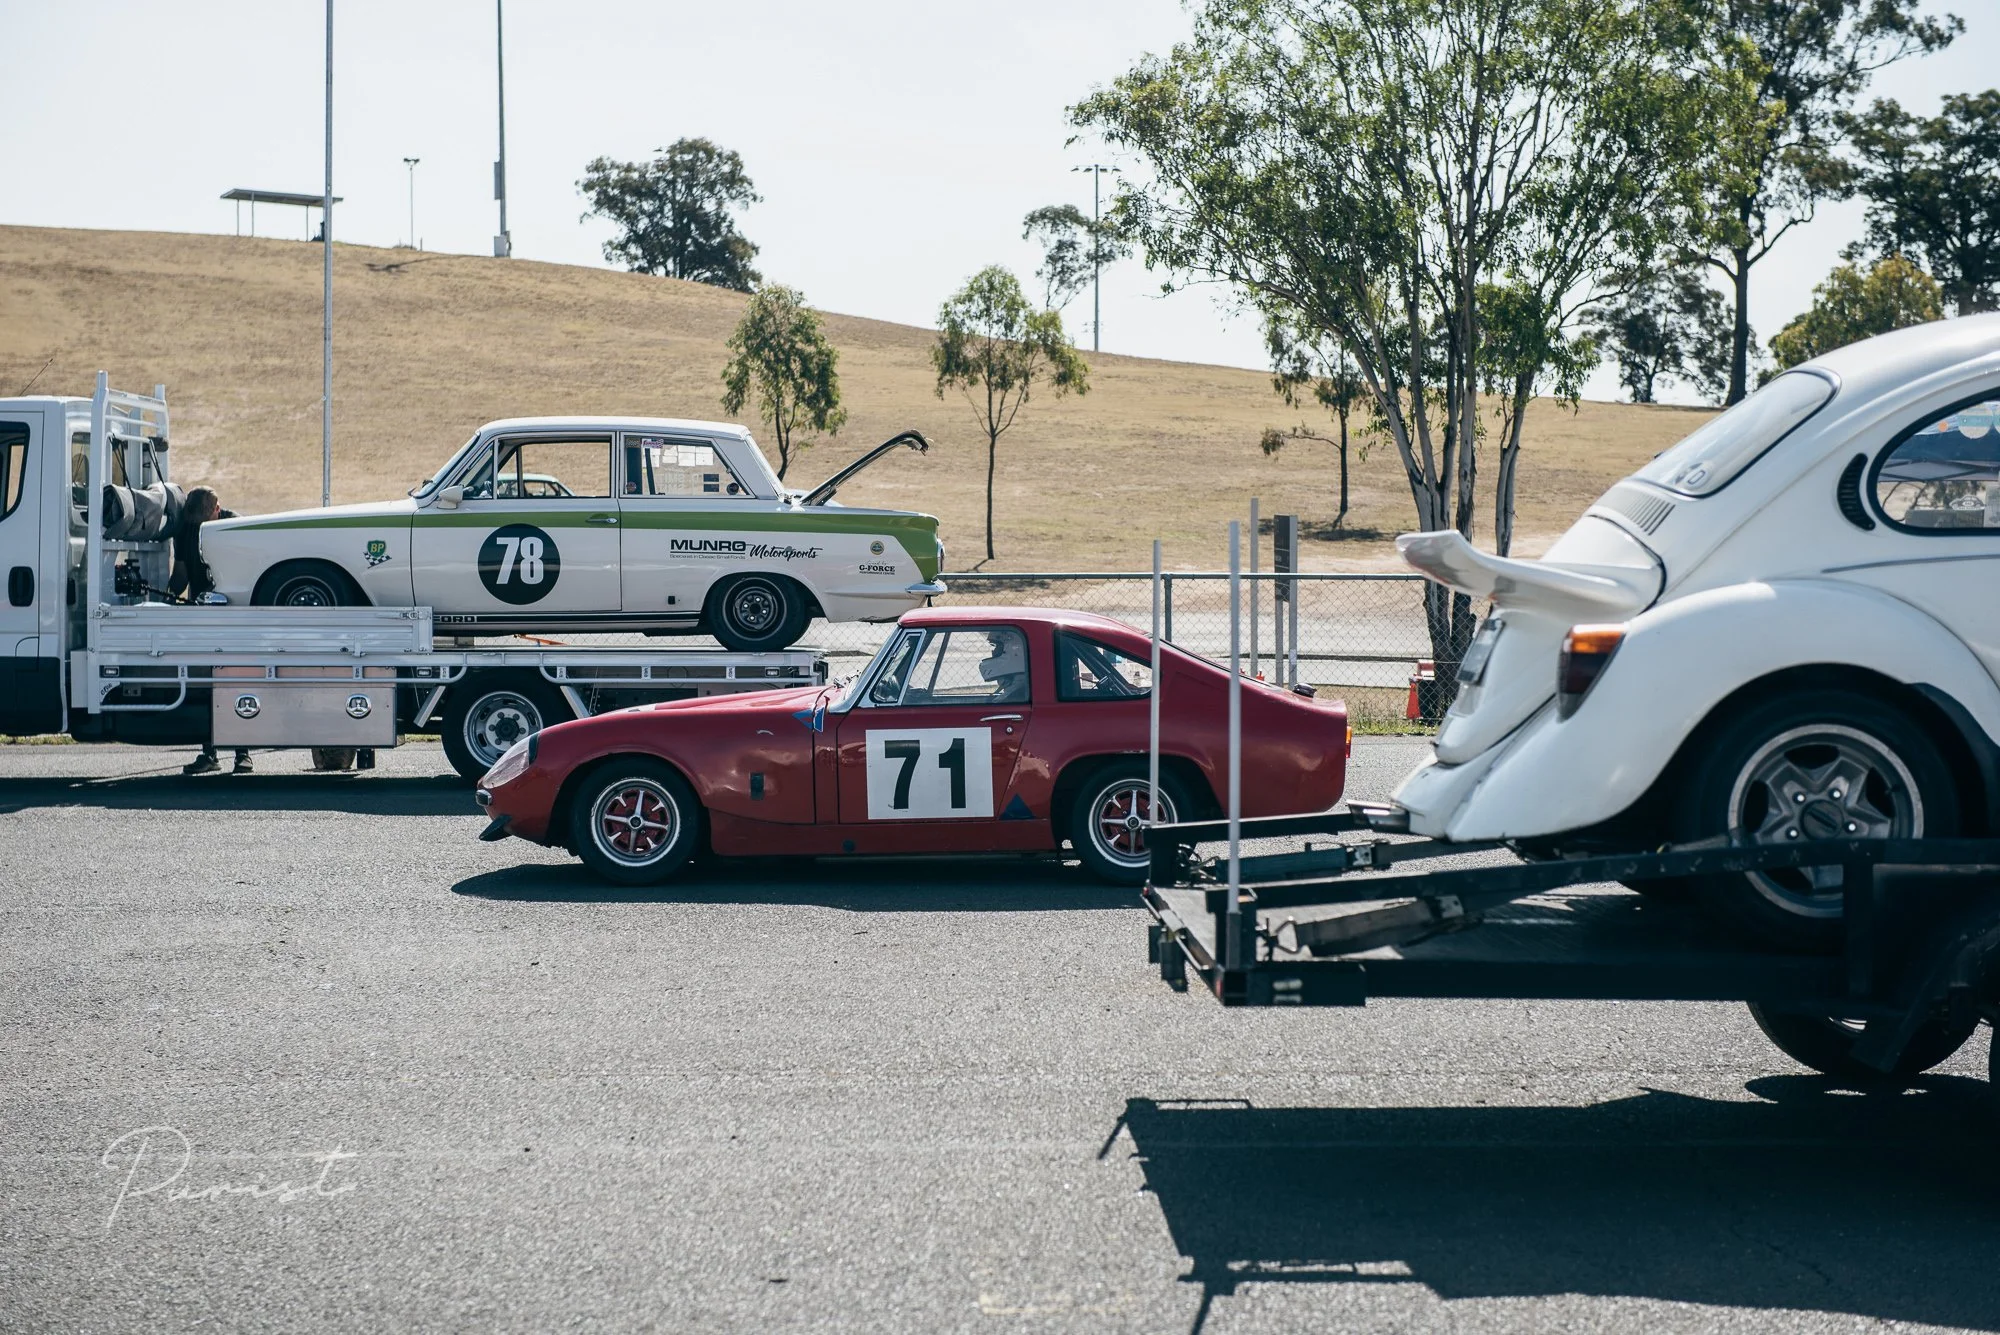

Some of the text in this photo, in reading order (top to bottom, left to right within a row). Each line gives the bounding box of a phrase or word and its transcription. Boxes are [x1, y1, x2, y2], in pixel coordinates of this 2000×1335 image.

[370, 542, 385, 553] BP
[670, 539, 824, 562] MUNRO Motorsports
[496, 537, 544, 585] 78
[859, 564, 895, 572] G-FORCE
[884, 738, 966, 810] 71
